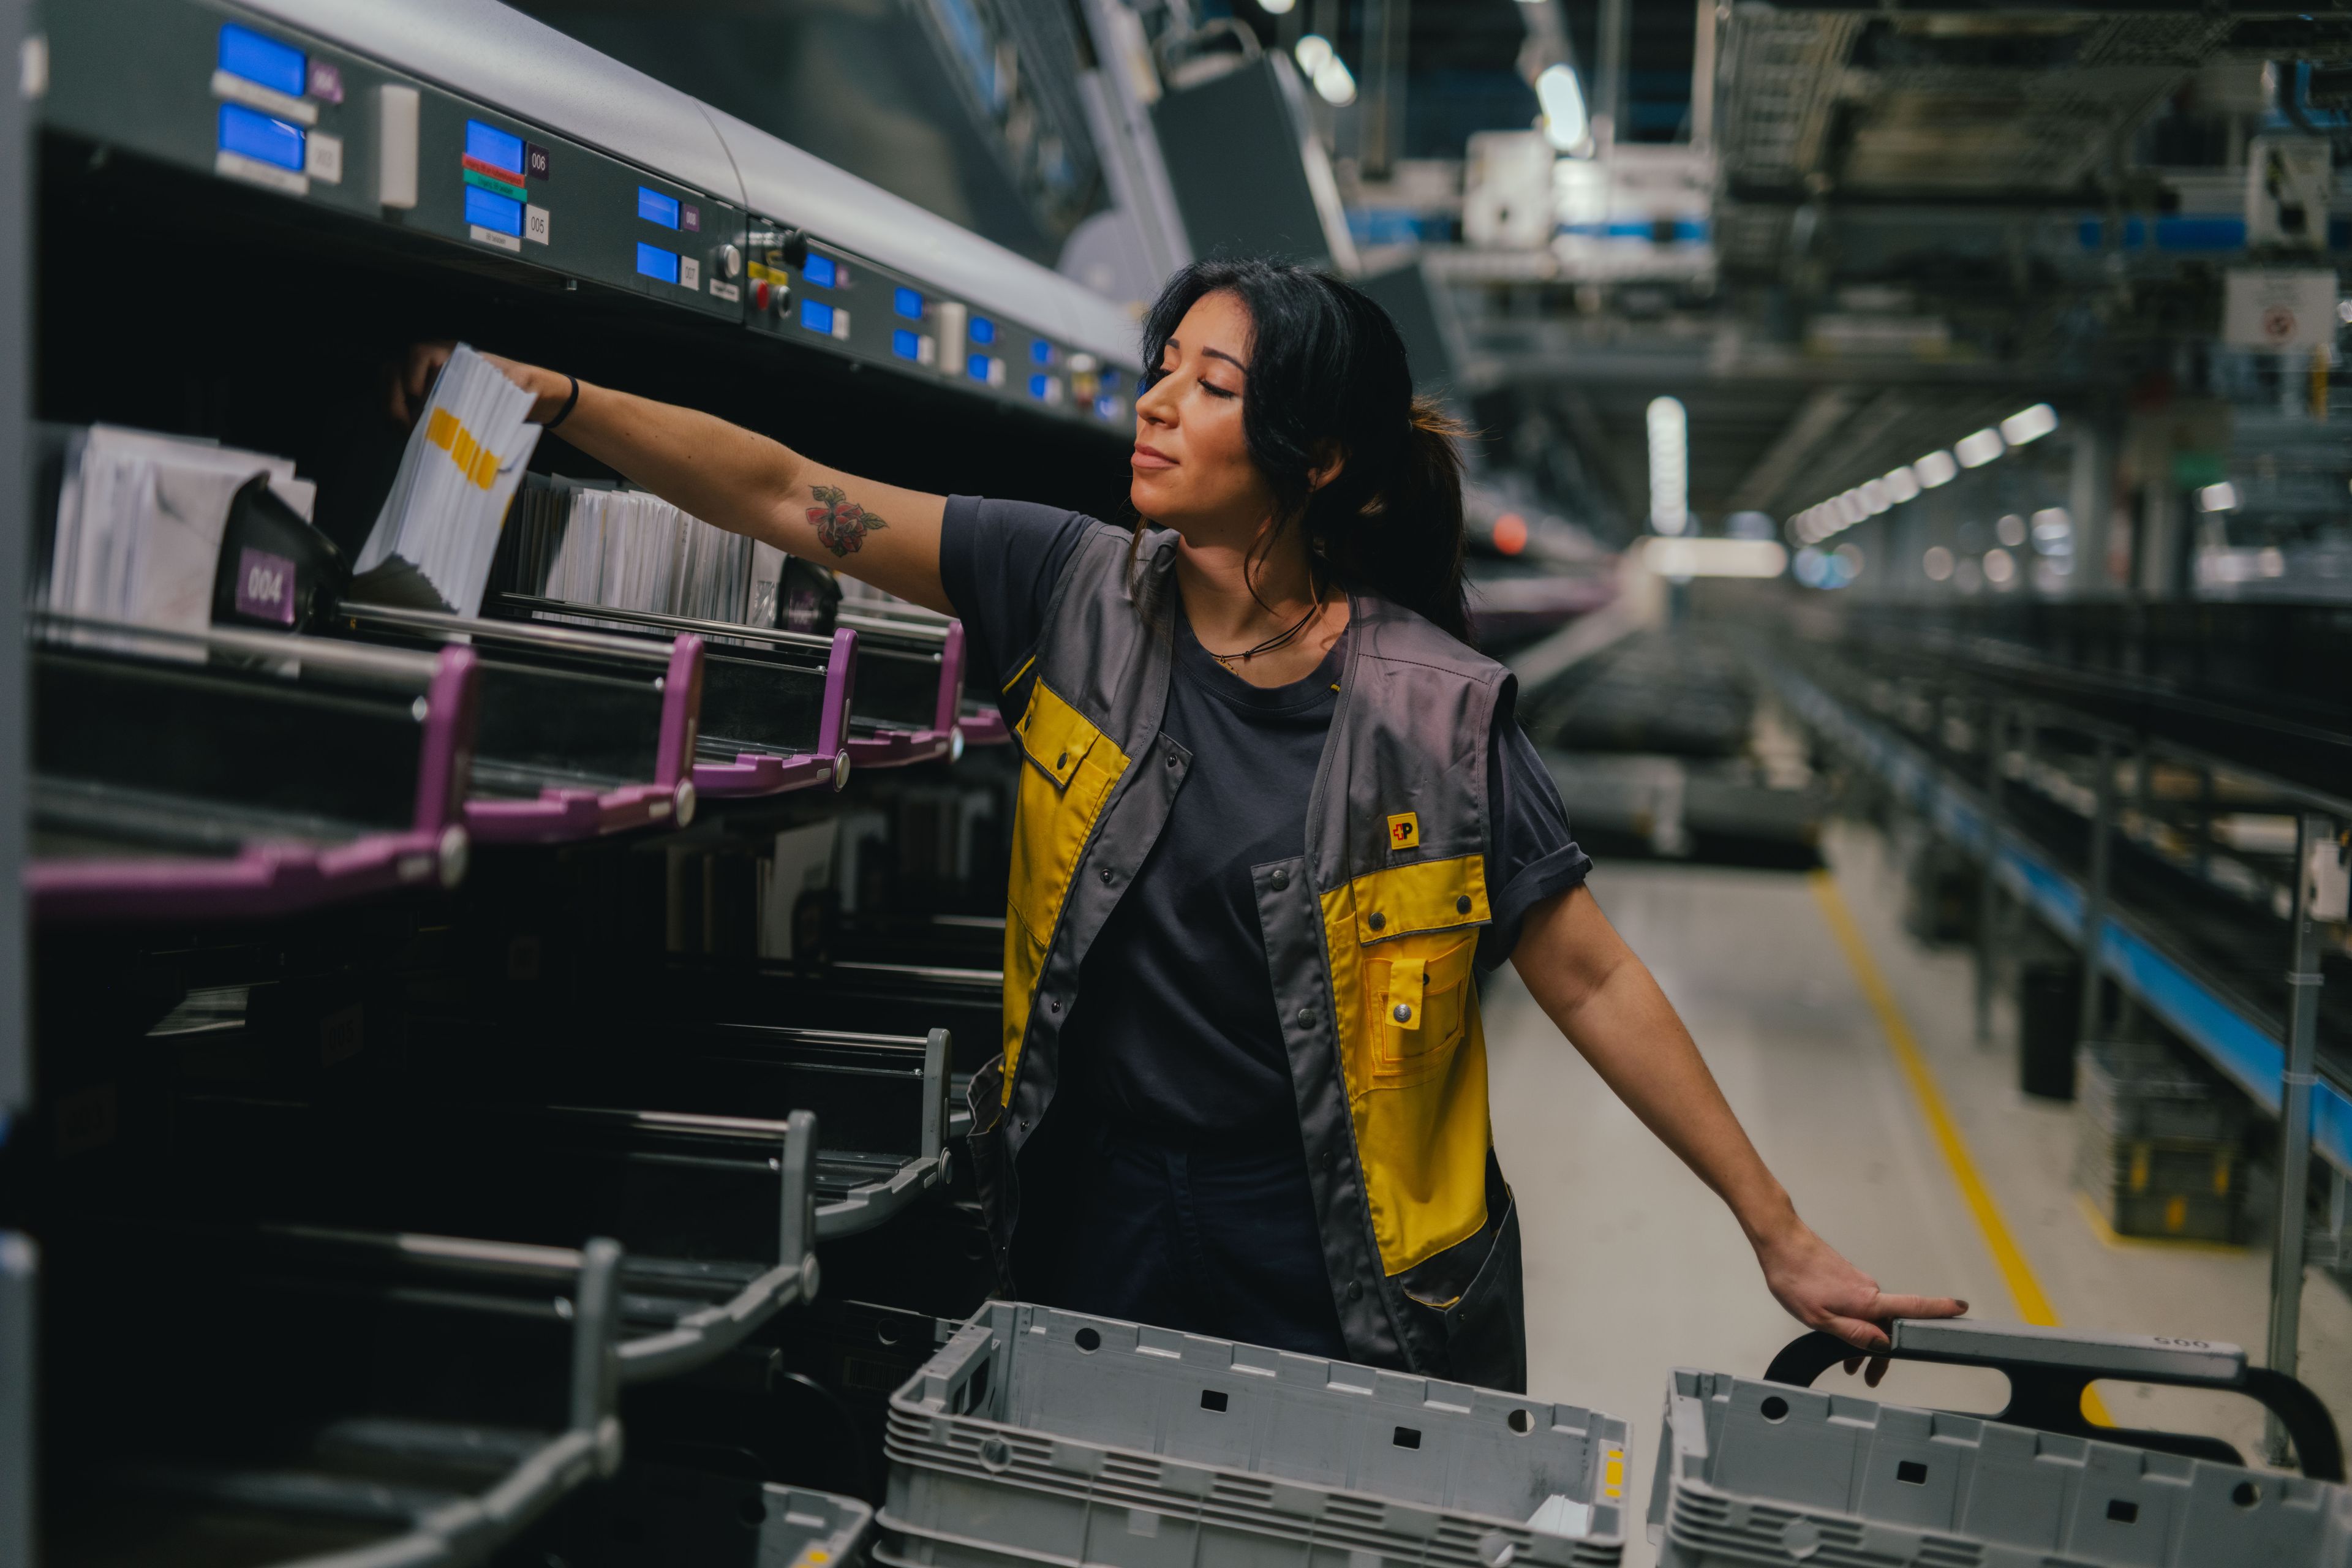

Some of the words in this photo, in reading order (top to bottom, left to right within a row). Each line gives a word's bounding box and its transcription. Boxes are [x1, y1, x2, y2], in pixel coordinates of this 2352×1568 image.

[532, 153, 545, 171] 006
[531, 216, 544, 233] 005
[248, 567, 283, 603] 004
